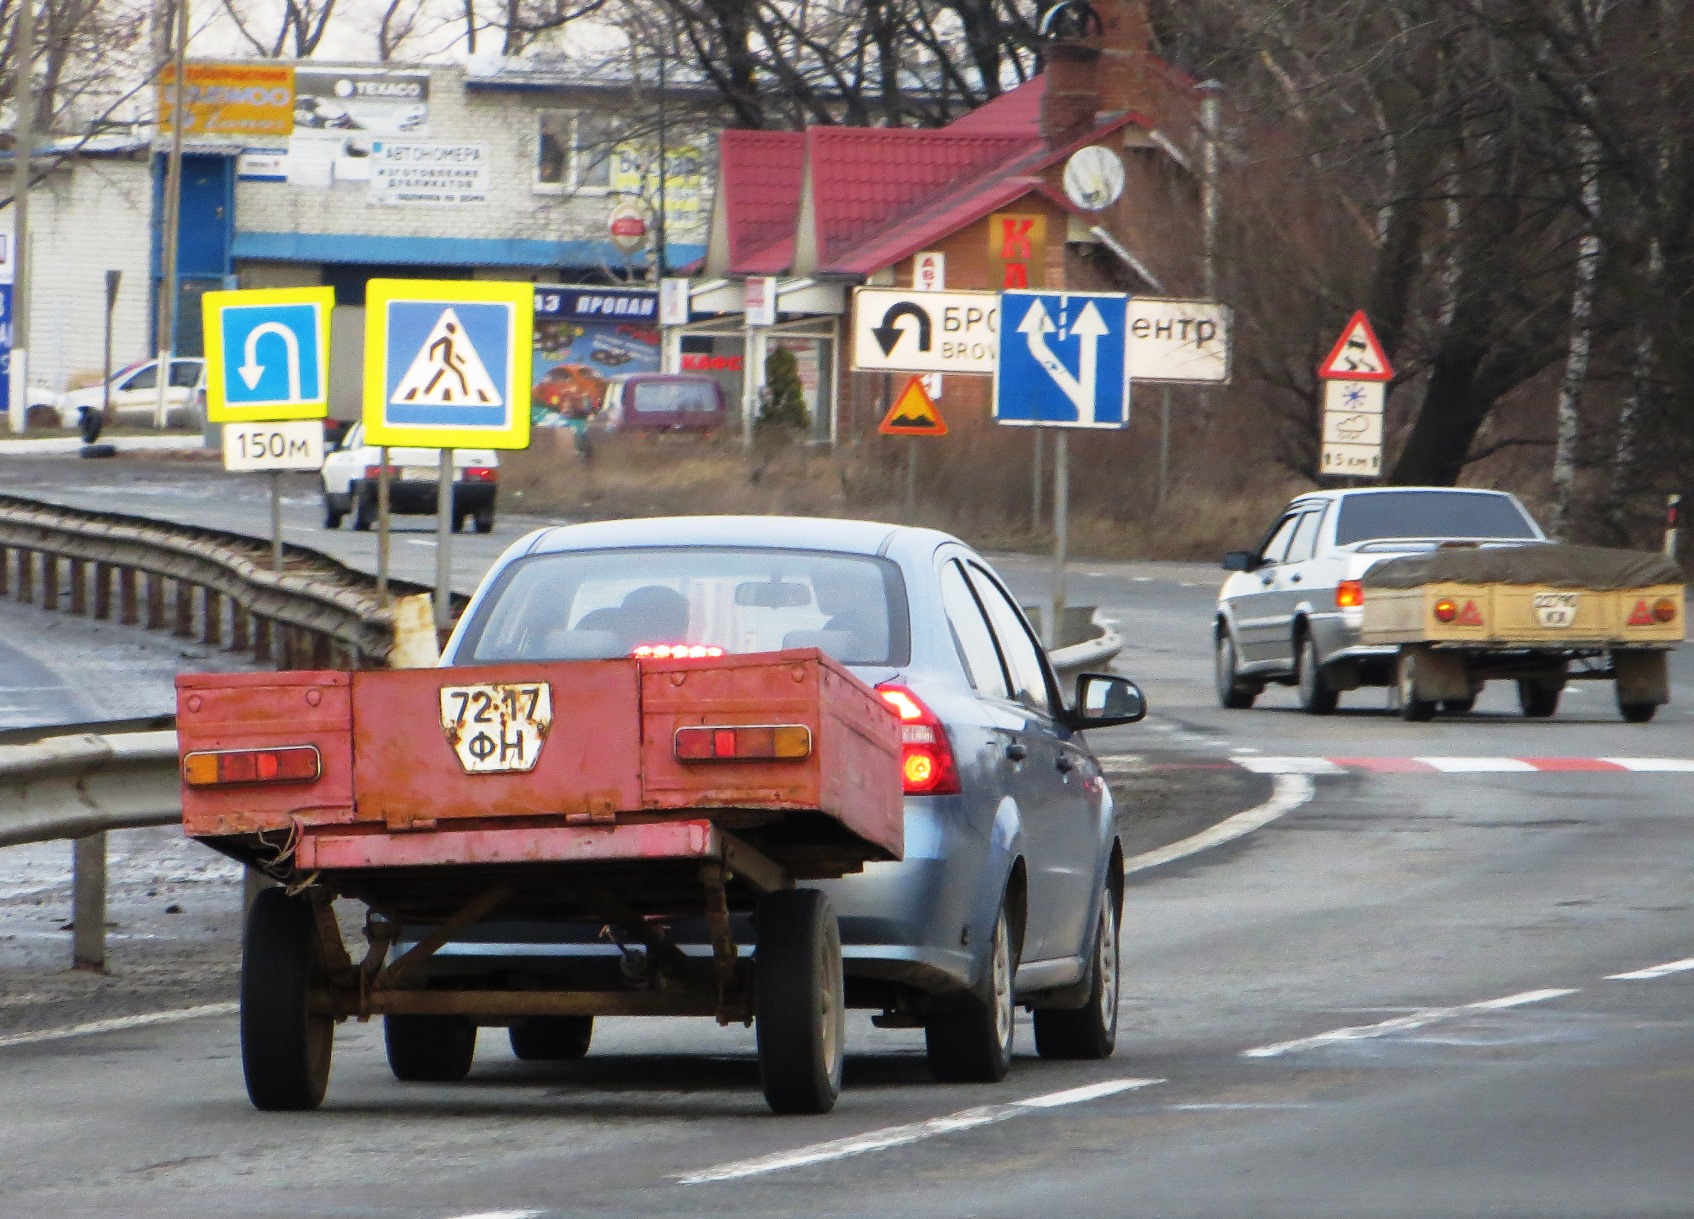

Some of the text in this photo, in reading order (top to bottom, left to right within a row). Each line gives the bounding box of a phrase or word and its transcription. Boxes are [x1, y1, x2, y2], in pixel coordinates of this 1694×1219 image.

[356, 81, 421, 98] TEXACO
[386, 146, 480, 161] АВТОНОМЕРА
[387, 179, 473, 188] ДУБЛИКАТОВ
[576, 295, 656, 315] ПРОПАН
[1131, 318, 1217, 349] ентр
[450, 687, 540, 726] 7217
[468, 730, 525, 762] ФН
